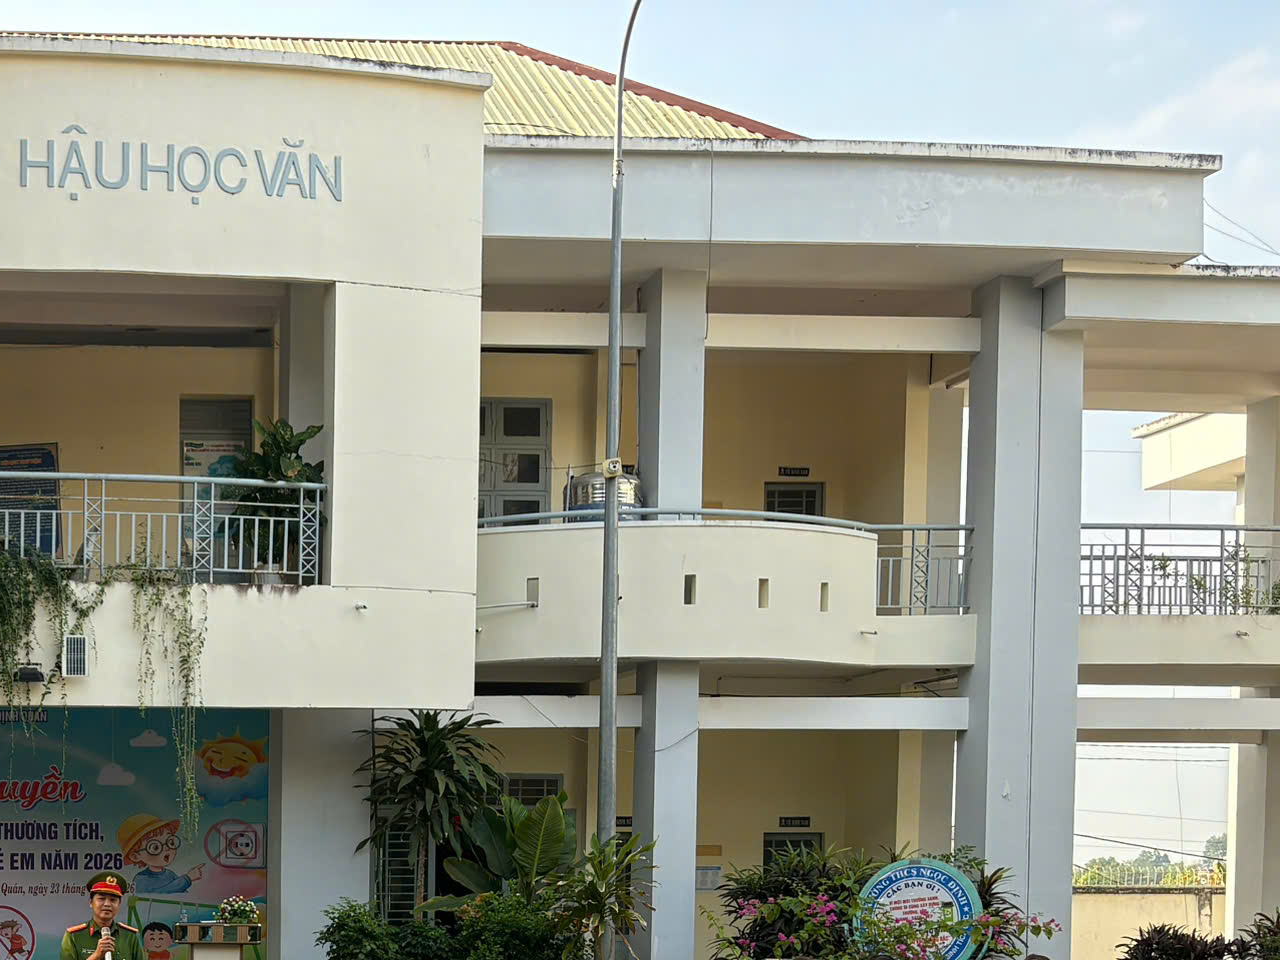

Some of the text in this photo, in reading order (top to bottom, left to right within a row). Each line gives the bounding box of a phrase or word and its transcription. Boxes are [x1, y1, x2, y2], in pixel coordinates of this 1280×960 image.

[19, 124, 131, 201] HẬU
[140, 142, 248, 205] HỌC
[254, 137, 343, 202] VĂN
[63, 819, 104, 842] TÍCH,
[9, 853, 35, 871] EM
[41, 850, 79, 871] NĂM
[83, 853, 123, 871] 2026
[890, 867, 917, 881] THCS
[920, 868, 949, 884] NGỌC
[1, 882, 25, 896] Quán,
[28, 883, 48, 897] ngày
[62, 882, 87, 897] tháng
[886, 885, 903, 899] CÁC
[904, 880, 923, 890] BẠN
